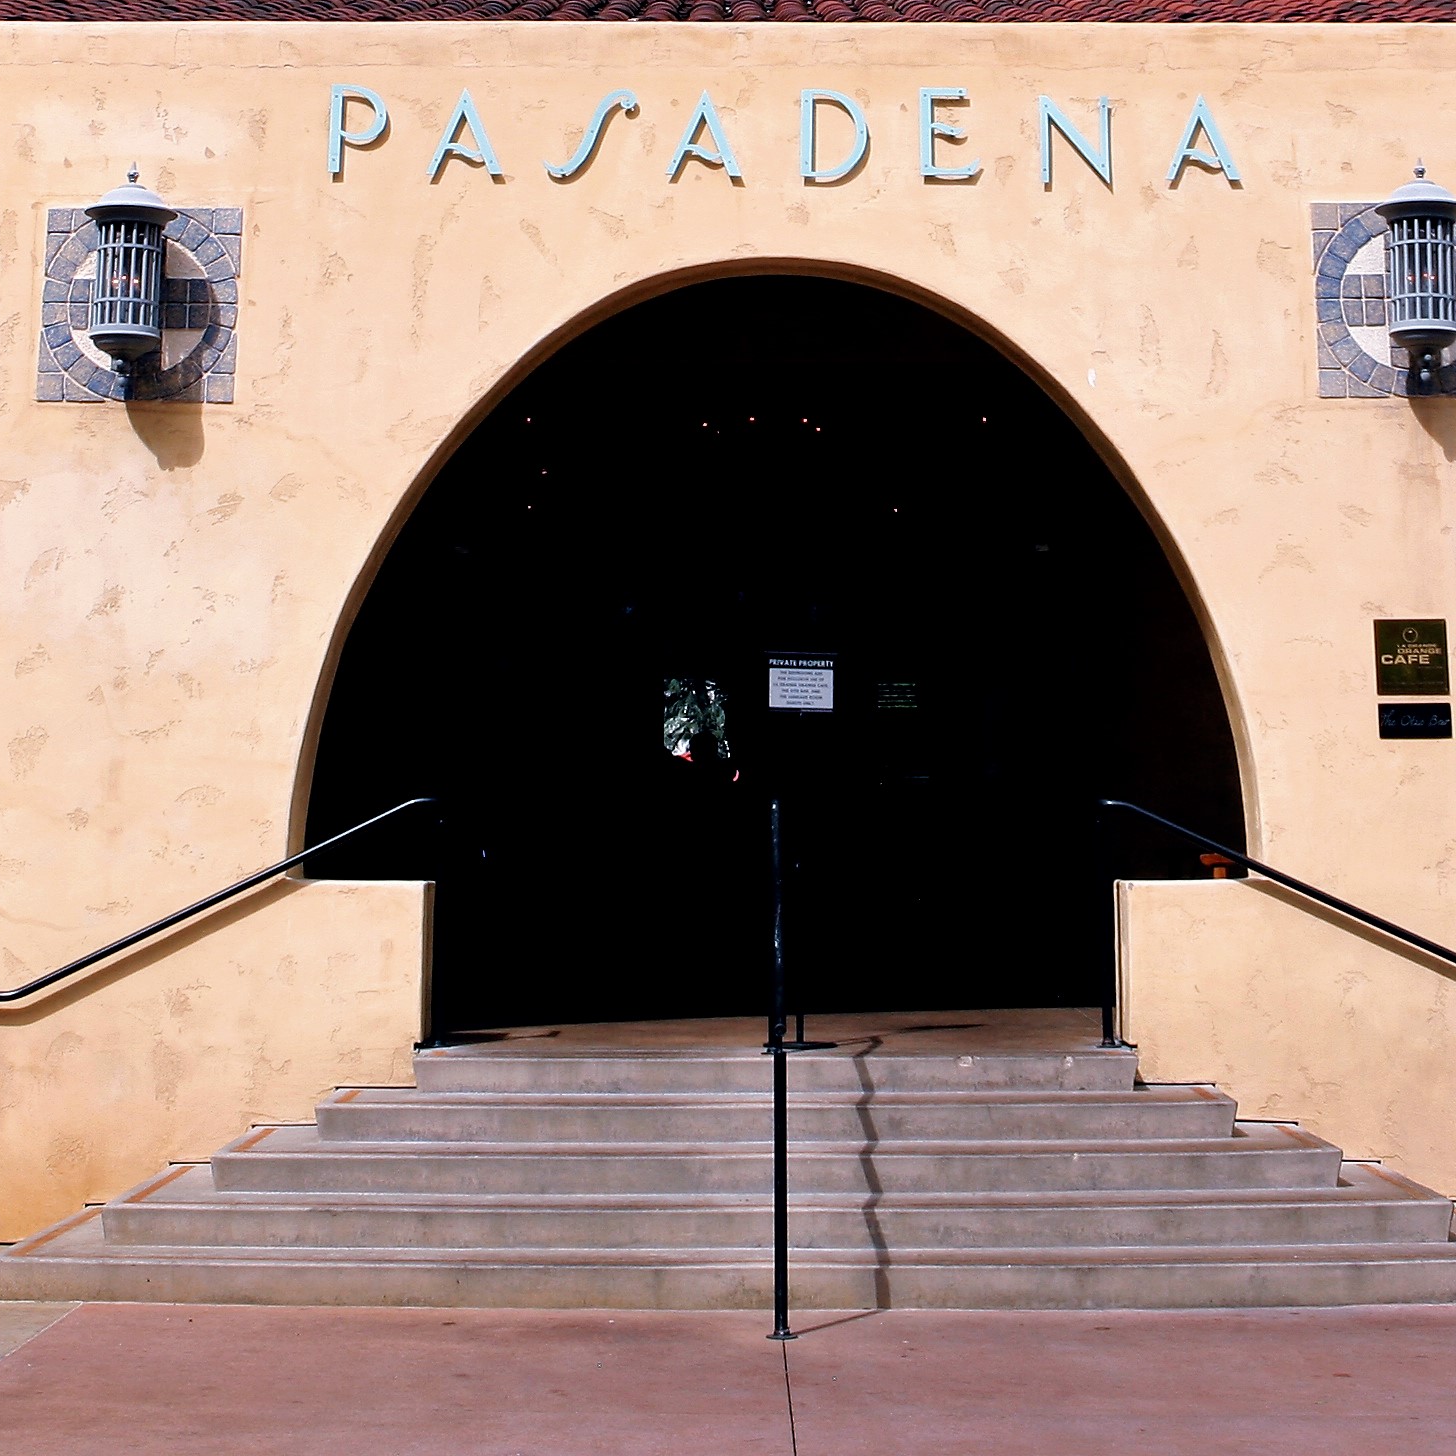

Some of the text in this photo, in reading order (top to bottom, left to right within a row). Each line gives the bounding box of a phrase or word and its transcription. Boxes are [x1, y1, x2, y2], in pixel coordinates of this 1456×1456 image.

[326, 83, 1241, 185] PASADENA
[1397, 647, 1442, 655] ORANGE
[1381, 654, 1430, 665] CAFE
